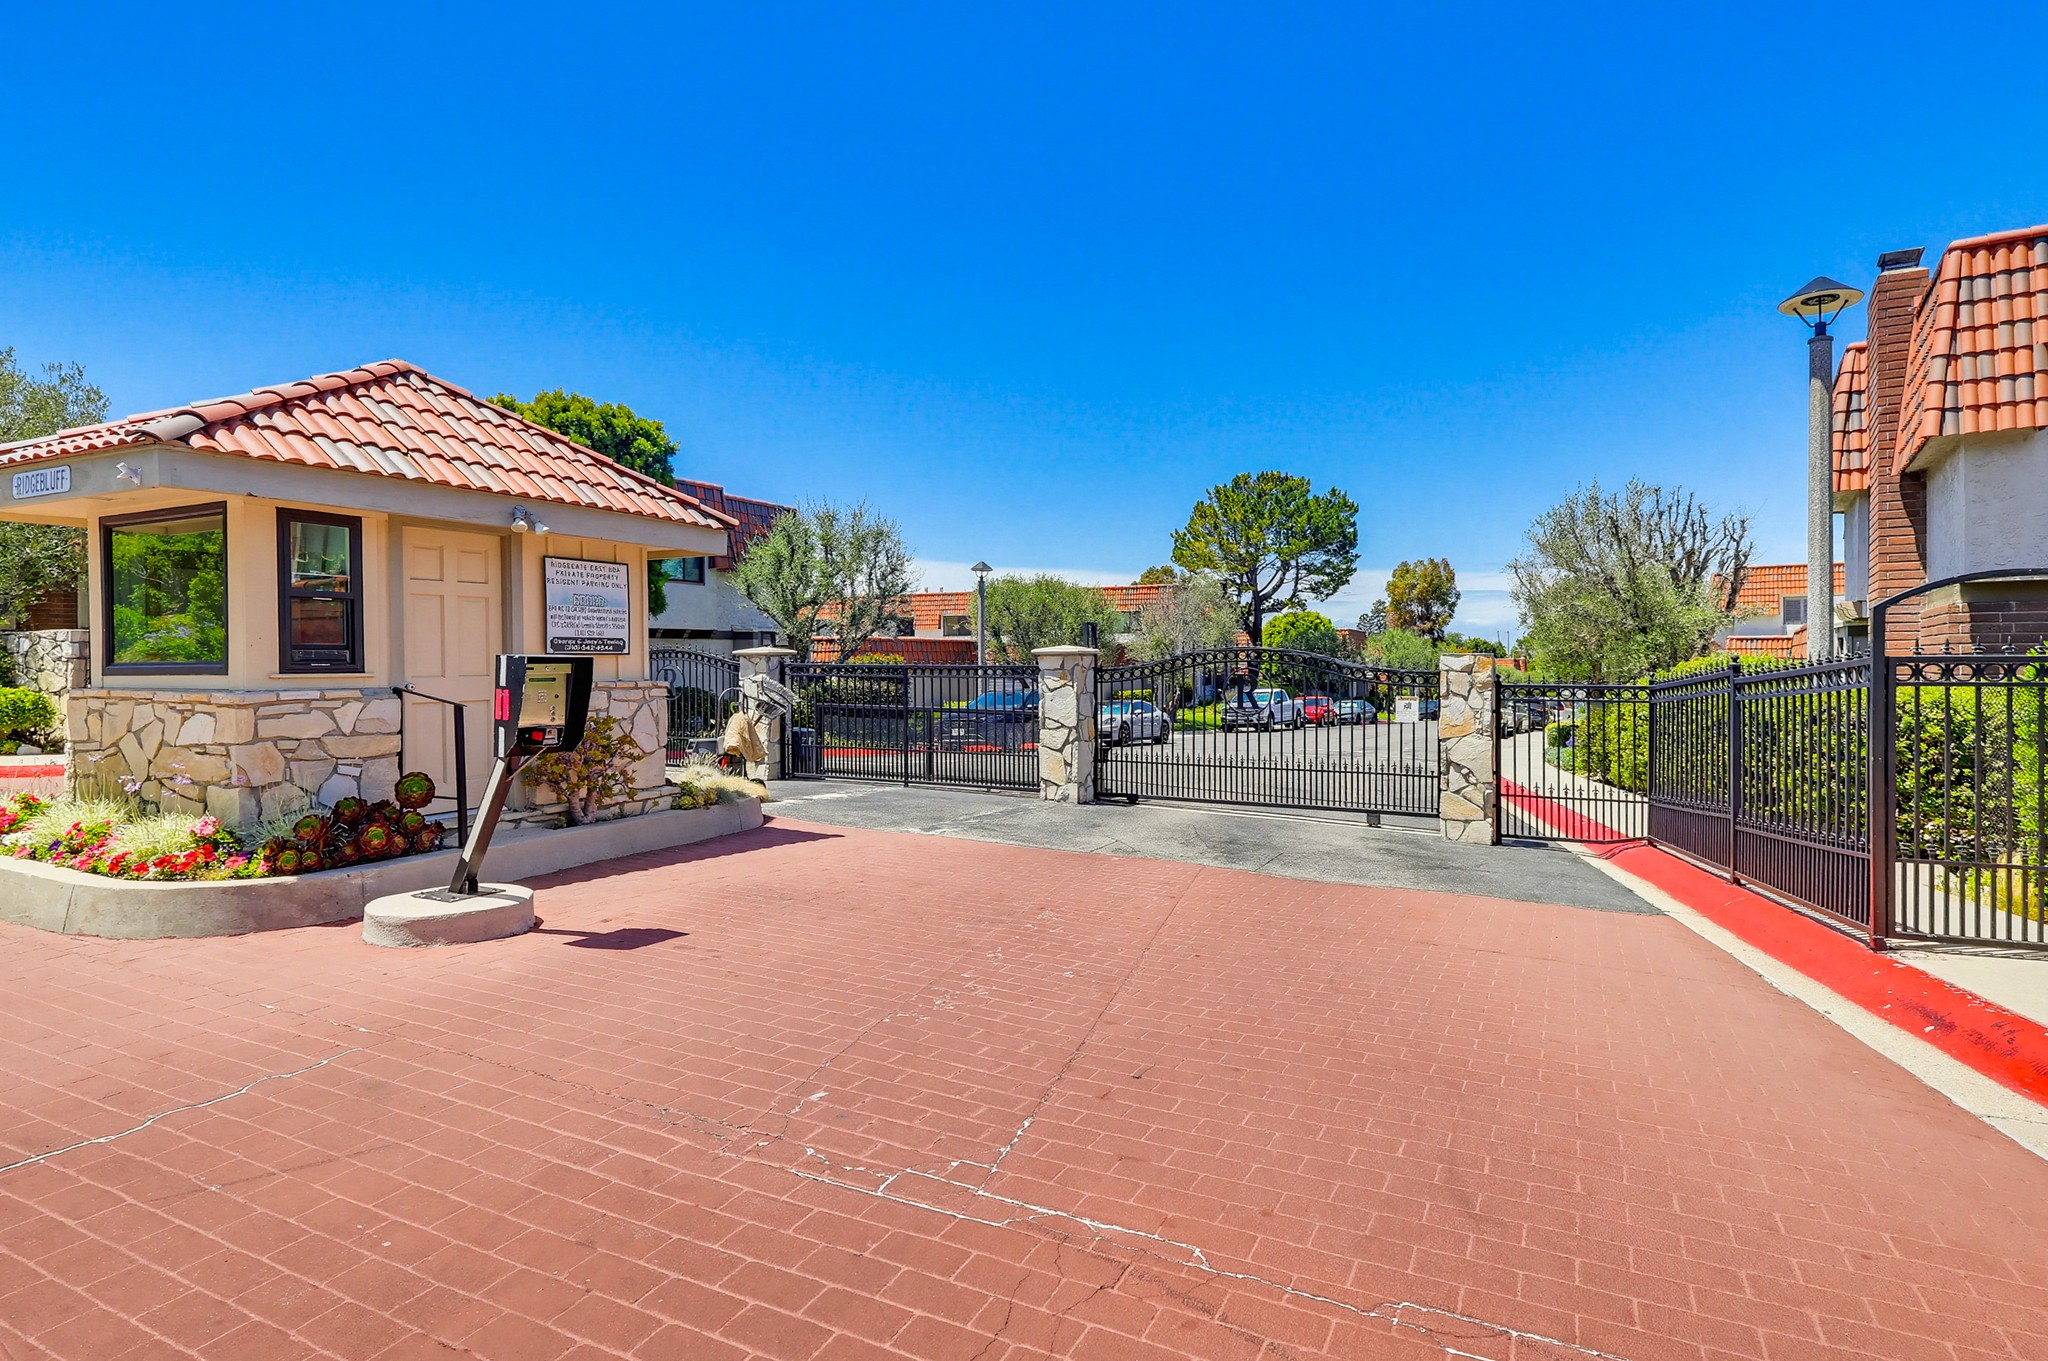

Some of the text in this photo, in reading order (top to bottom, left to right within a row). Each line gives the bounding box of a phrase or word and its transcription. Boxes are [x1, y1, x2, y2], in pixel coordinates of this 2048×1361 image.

[16, 469, 66, 495] RIDGEBLUFF
[546, 577, 579, 586] RESIDENT
[555, 569, 619, 580] PRIVATE PROPERTY
[1236, 674, 1260, 709] R
